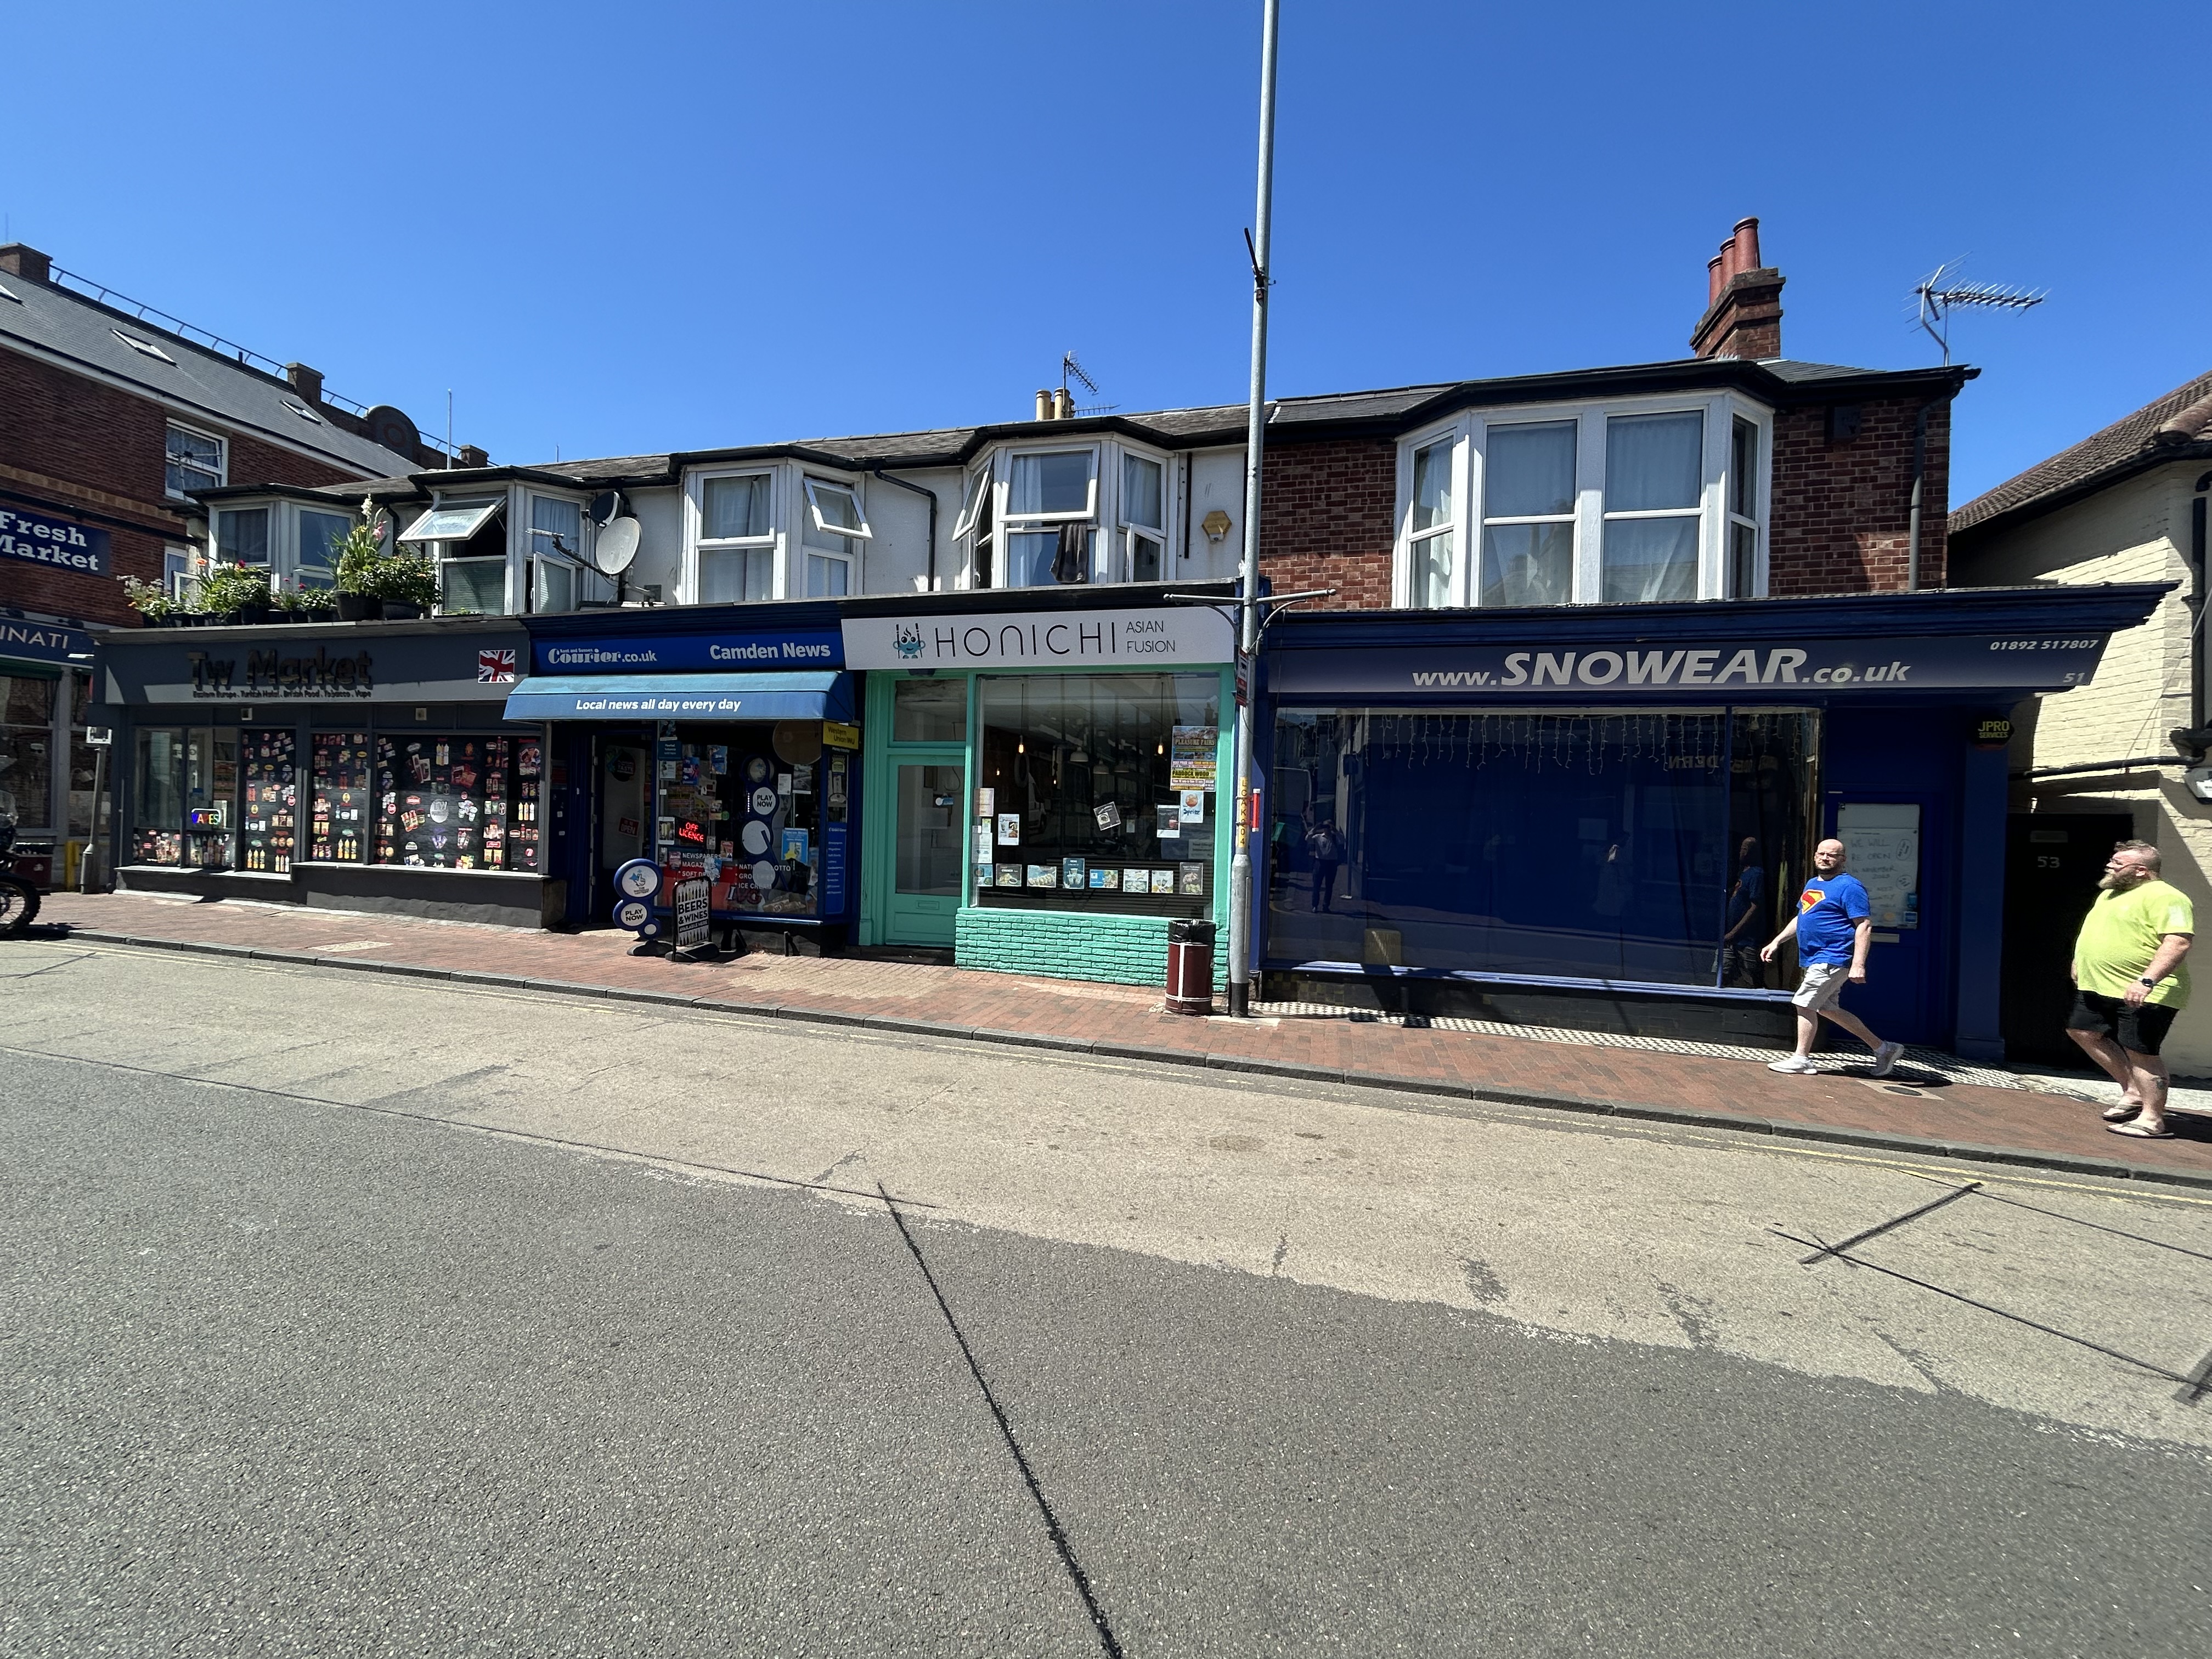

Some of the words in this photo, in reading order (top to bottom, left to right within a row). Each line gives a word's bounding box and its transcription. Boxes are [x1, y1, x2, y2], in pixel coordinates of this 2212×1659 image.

[0, 510, 87, 547] Fresh
[1126, 620, 1164, 634] ASIAN
[935, 622, 1116, 658] HONICHI
[1127, 640, 1176, 653] FUSION
[1990, 641, 2038, 650] 01892
[2040, 640, 2099, 650] 517807
[549, 648, 658, 664] Courier.co.uk
[710, 644, 778, 660] Camden
[782, 642, 831, 658] News
[246, 646, 373, 687] Market
[1413, 648, 1911, 686] www.SNOWEAR.co.uk
[2063, 673, 2085, 682] 51
[323, 690, 351, 698] Tobacco
[356, 690, 371, 698] Vape
[576, 699, 606, 710] Local
[608, 702, 638, 710] news
[641, 699, 655, 709] all
[658, 699, 680, 712] day
[681, 701, 716, 712] every
[718, 699, 741, 712] day
[828, 726, 847, 735] Western
[1977, 721, 2010, 732] JPRO
[620, 824, 636, 834] OPEN
[686, 822, 699, 832] OFF
[679, 827, 705, 843] LICENCE
[1851, 839, 1864, 847] WE
[2037, 856, 2061, 868] 53
[678, 898, 708, 915] BEERS
